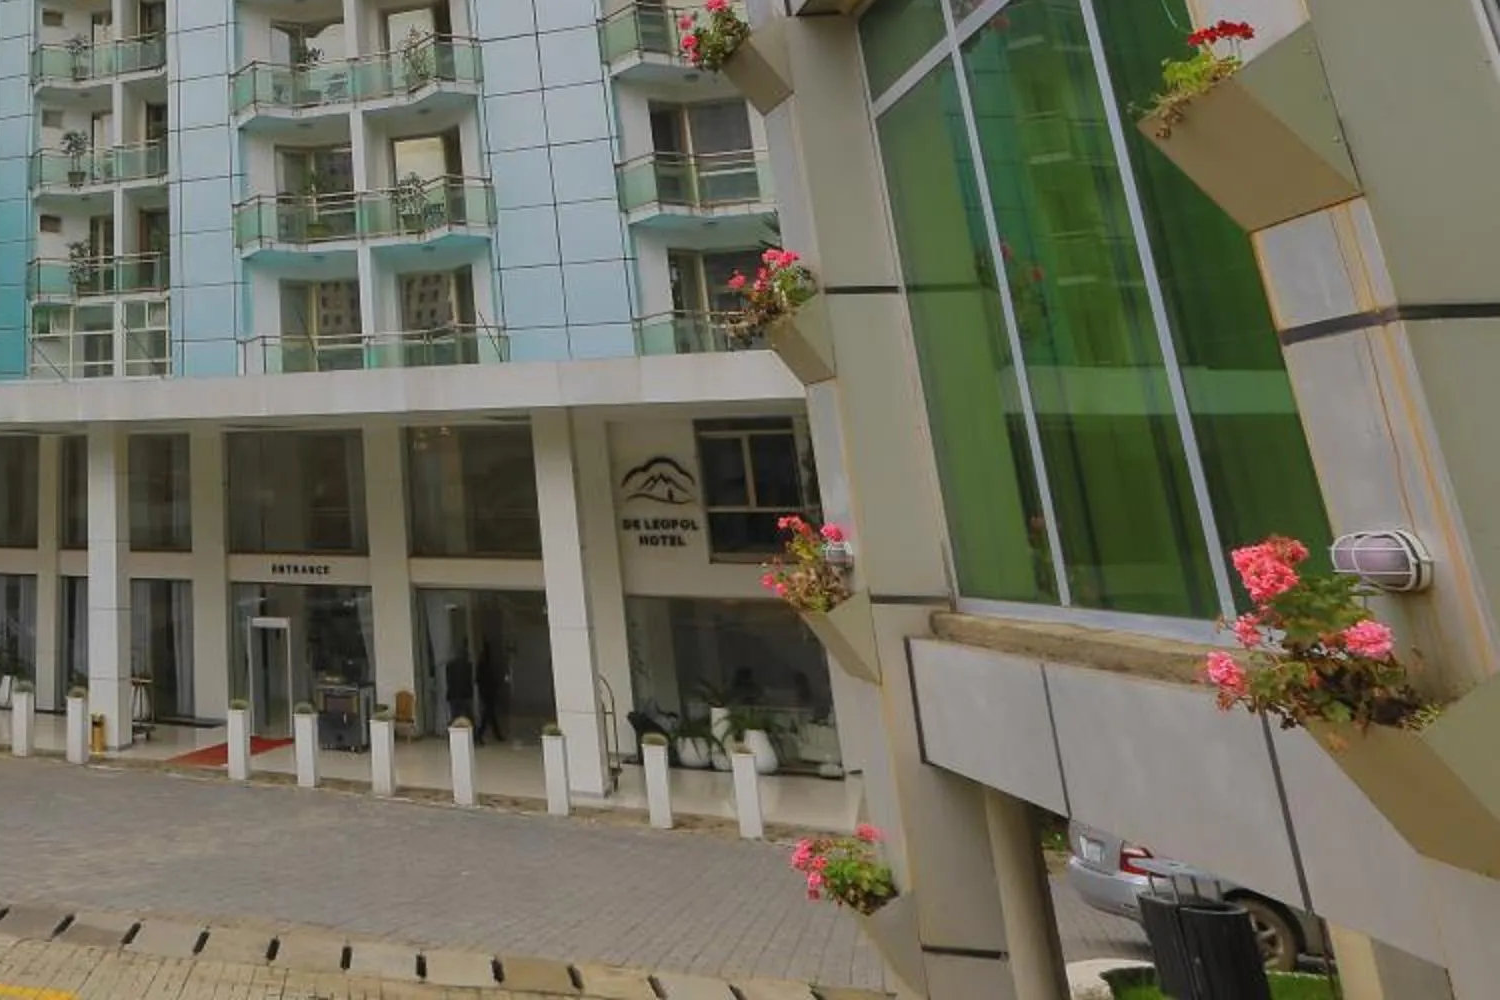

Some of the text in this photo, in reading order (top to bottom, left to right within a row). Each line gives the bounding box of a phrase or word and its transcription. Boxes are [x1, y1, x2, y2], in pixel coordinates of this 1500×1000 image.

[622, 518, 699, 531] DE LEOPOL
[638, 535, 687, 547] HOTEL
[271, 563, 332, 576] ENTRANCE
